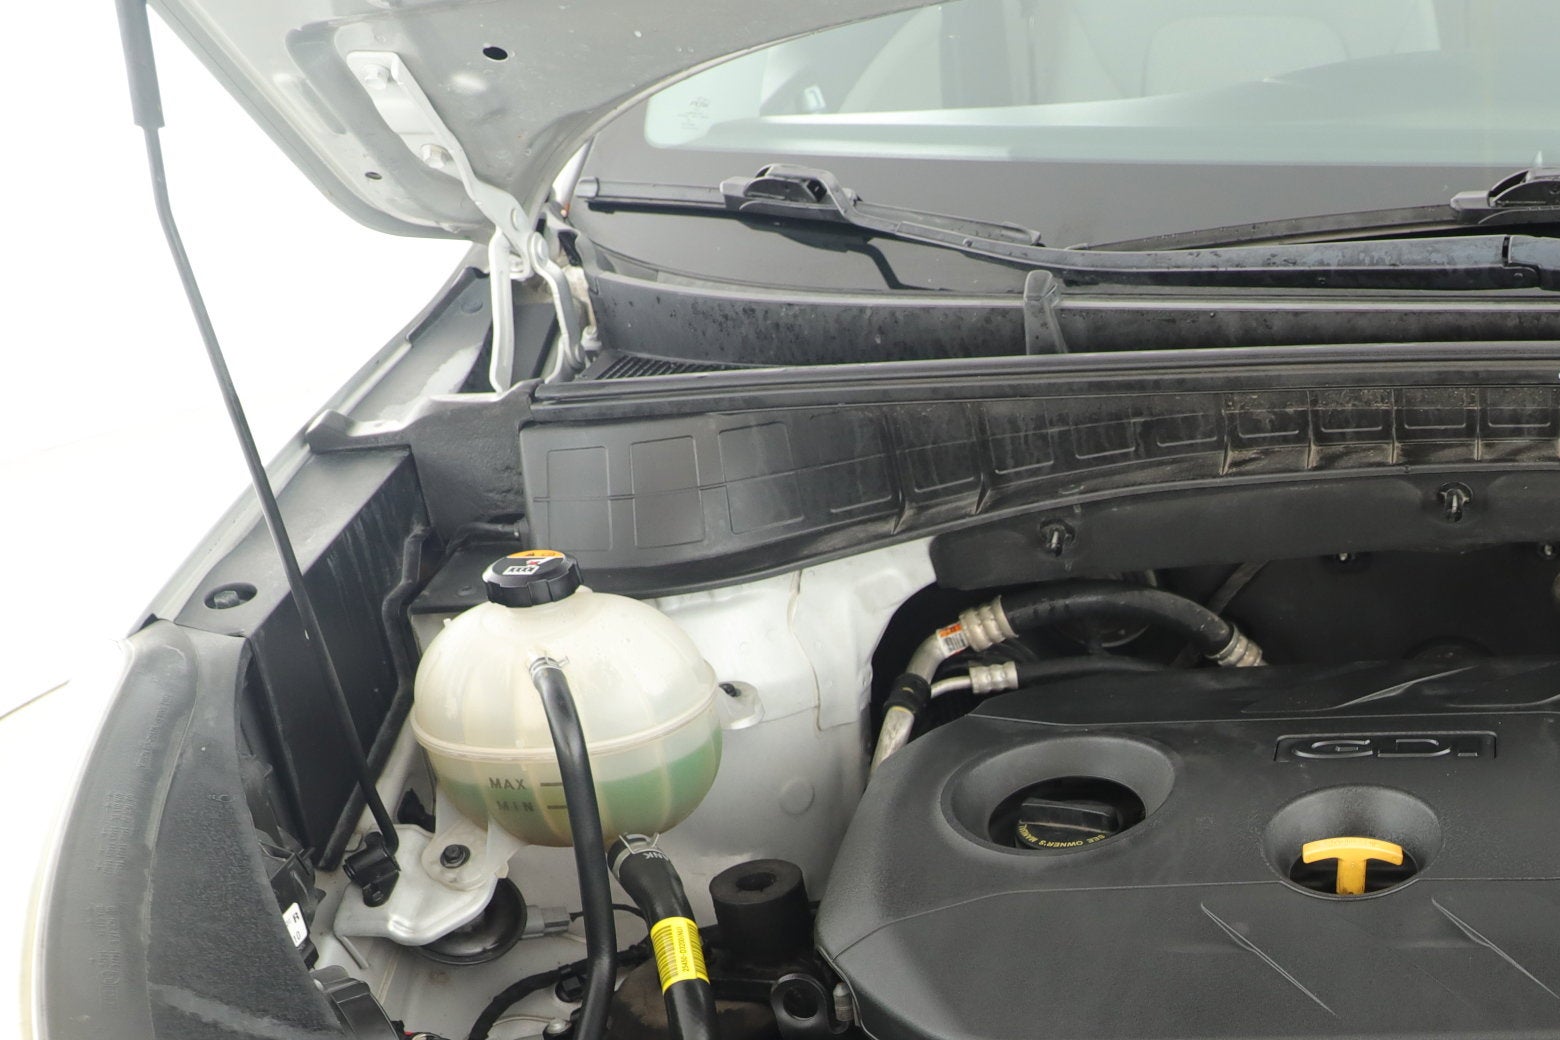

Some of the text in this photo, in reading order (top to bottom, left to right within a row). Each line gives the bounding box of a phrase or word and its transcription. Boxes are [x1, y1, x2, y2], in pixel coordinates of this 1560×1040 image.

[488, 777, 527, 790] MAX
[496, 800, 535, 812] MIN
[1038, 839, 1084, 849] OWNER'S
[1087, 834, 1106, 844] SEE
